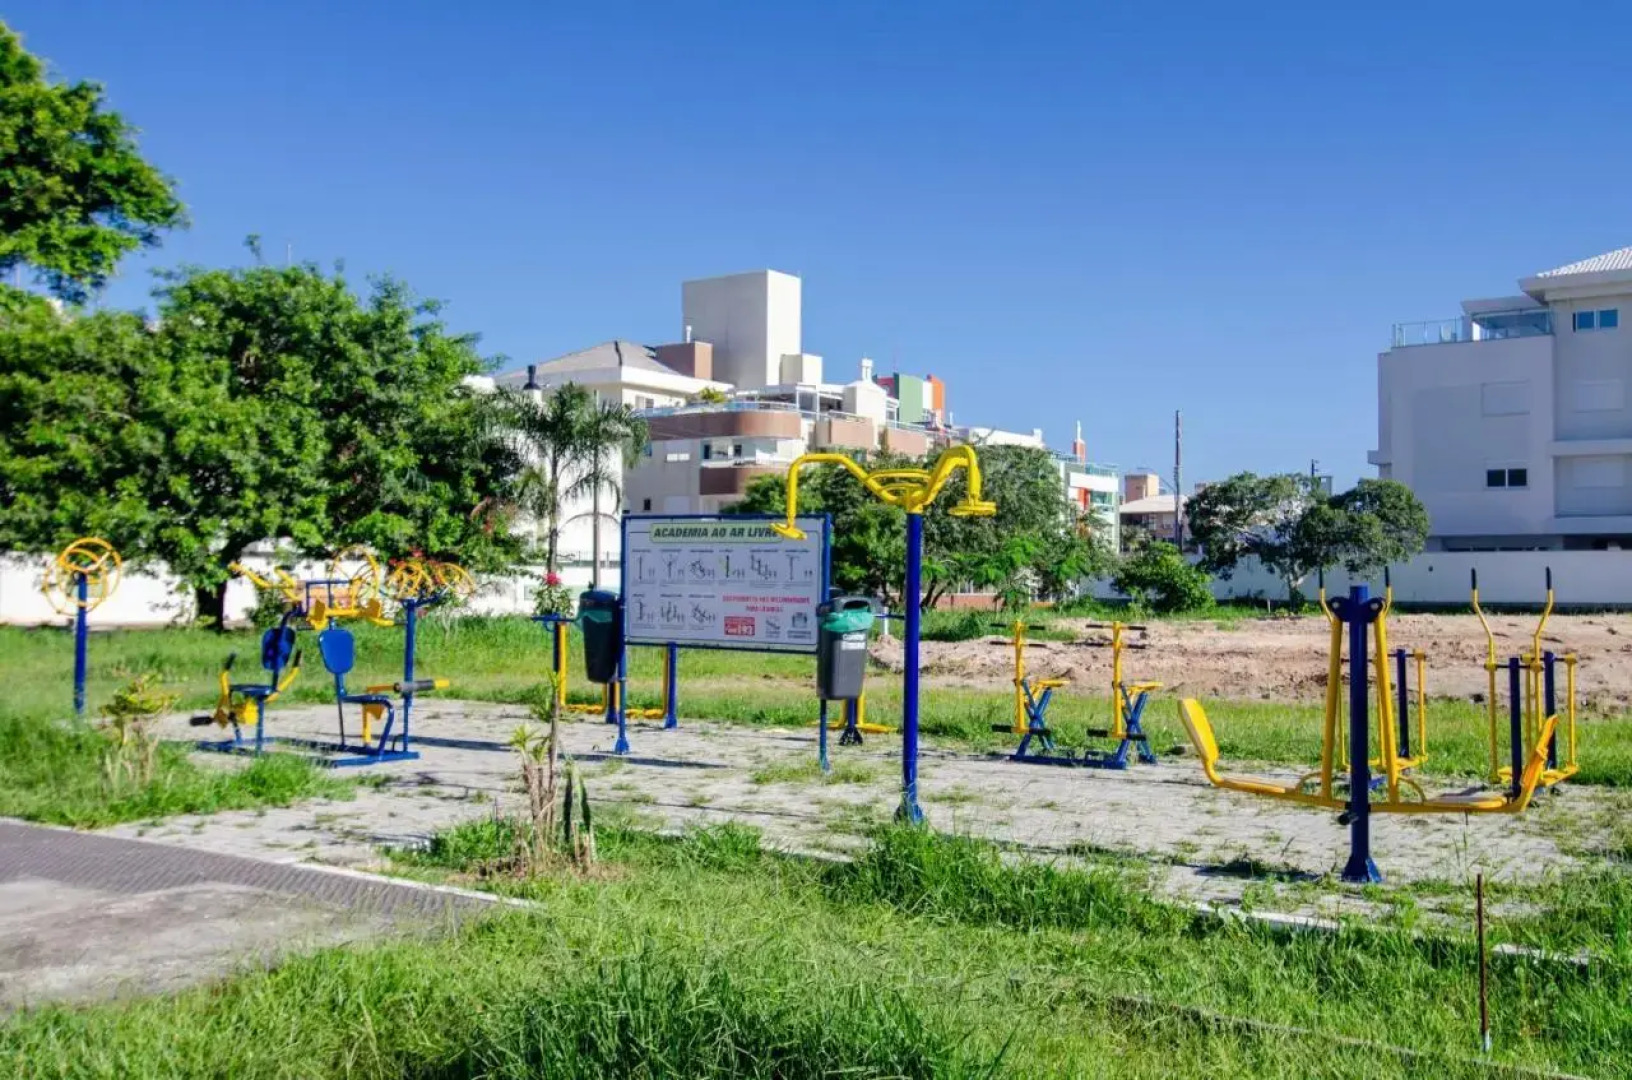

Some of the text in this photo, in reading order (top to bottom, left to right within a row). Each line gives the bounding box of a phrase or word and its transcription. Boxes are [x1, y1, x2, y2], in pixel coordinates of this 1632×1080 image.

[653, 527, 708, 538] ACADEMIA
[711, 527, 727, 538] AO
[729, 527, 746, 538] AR
